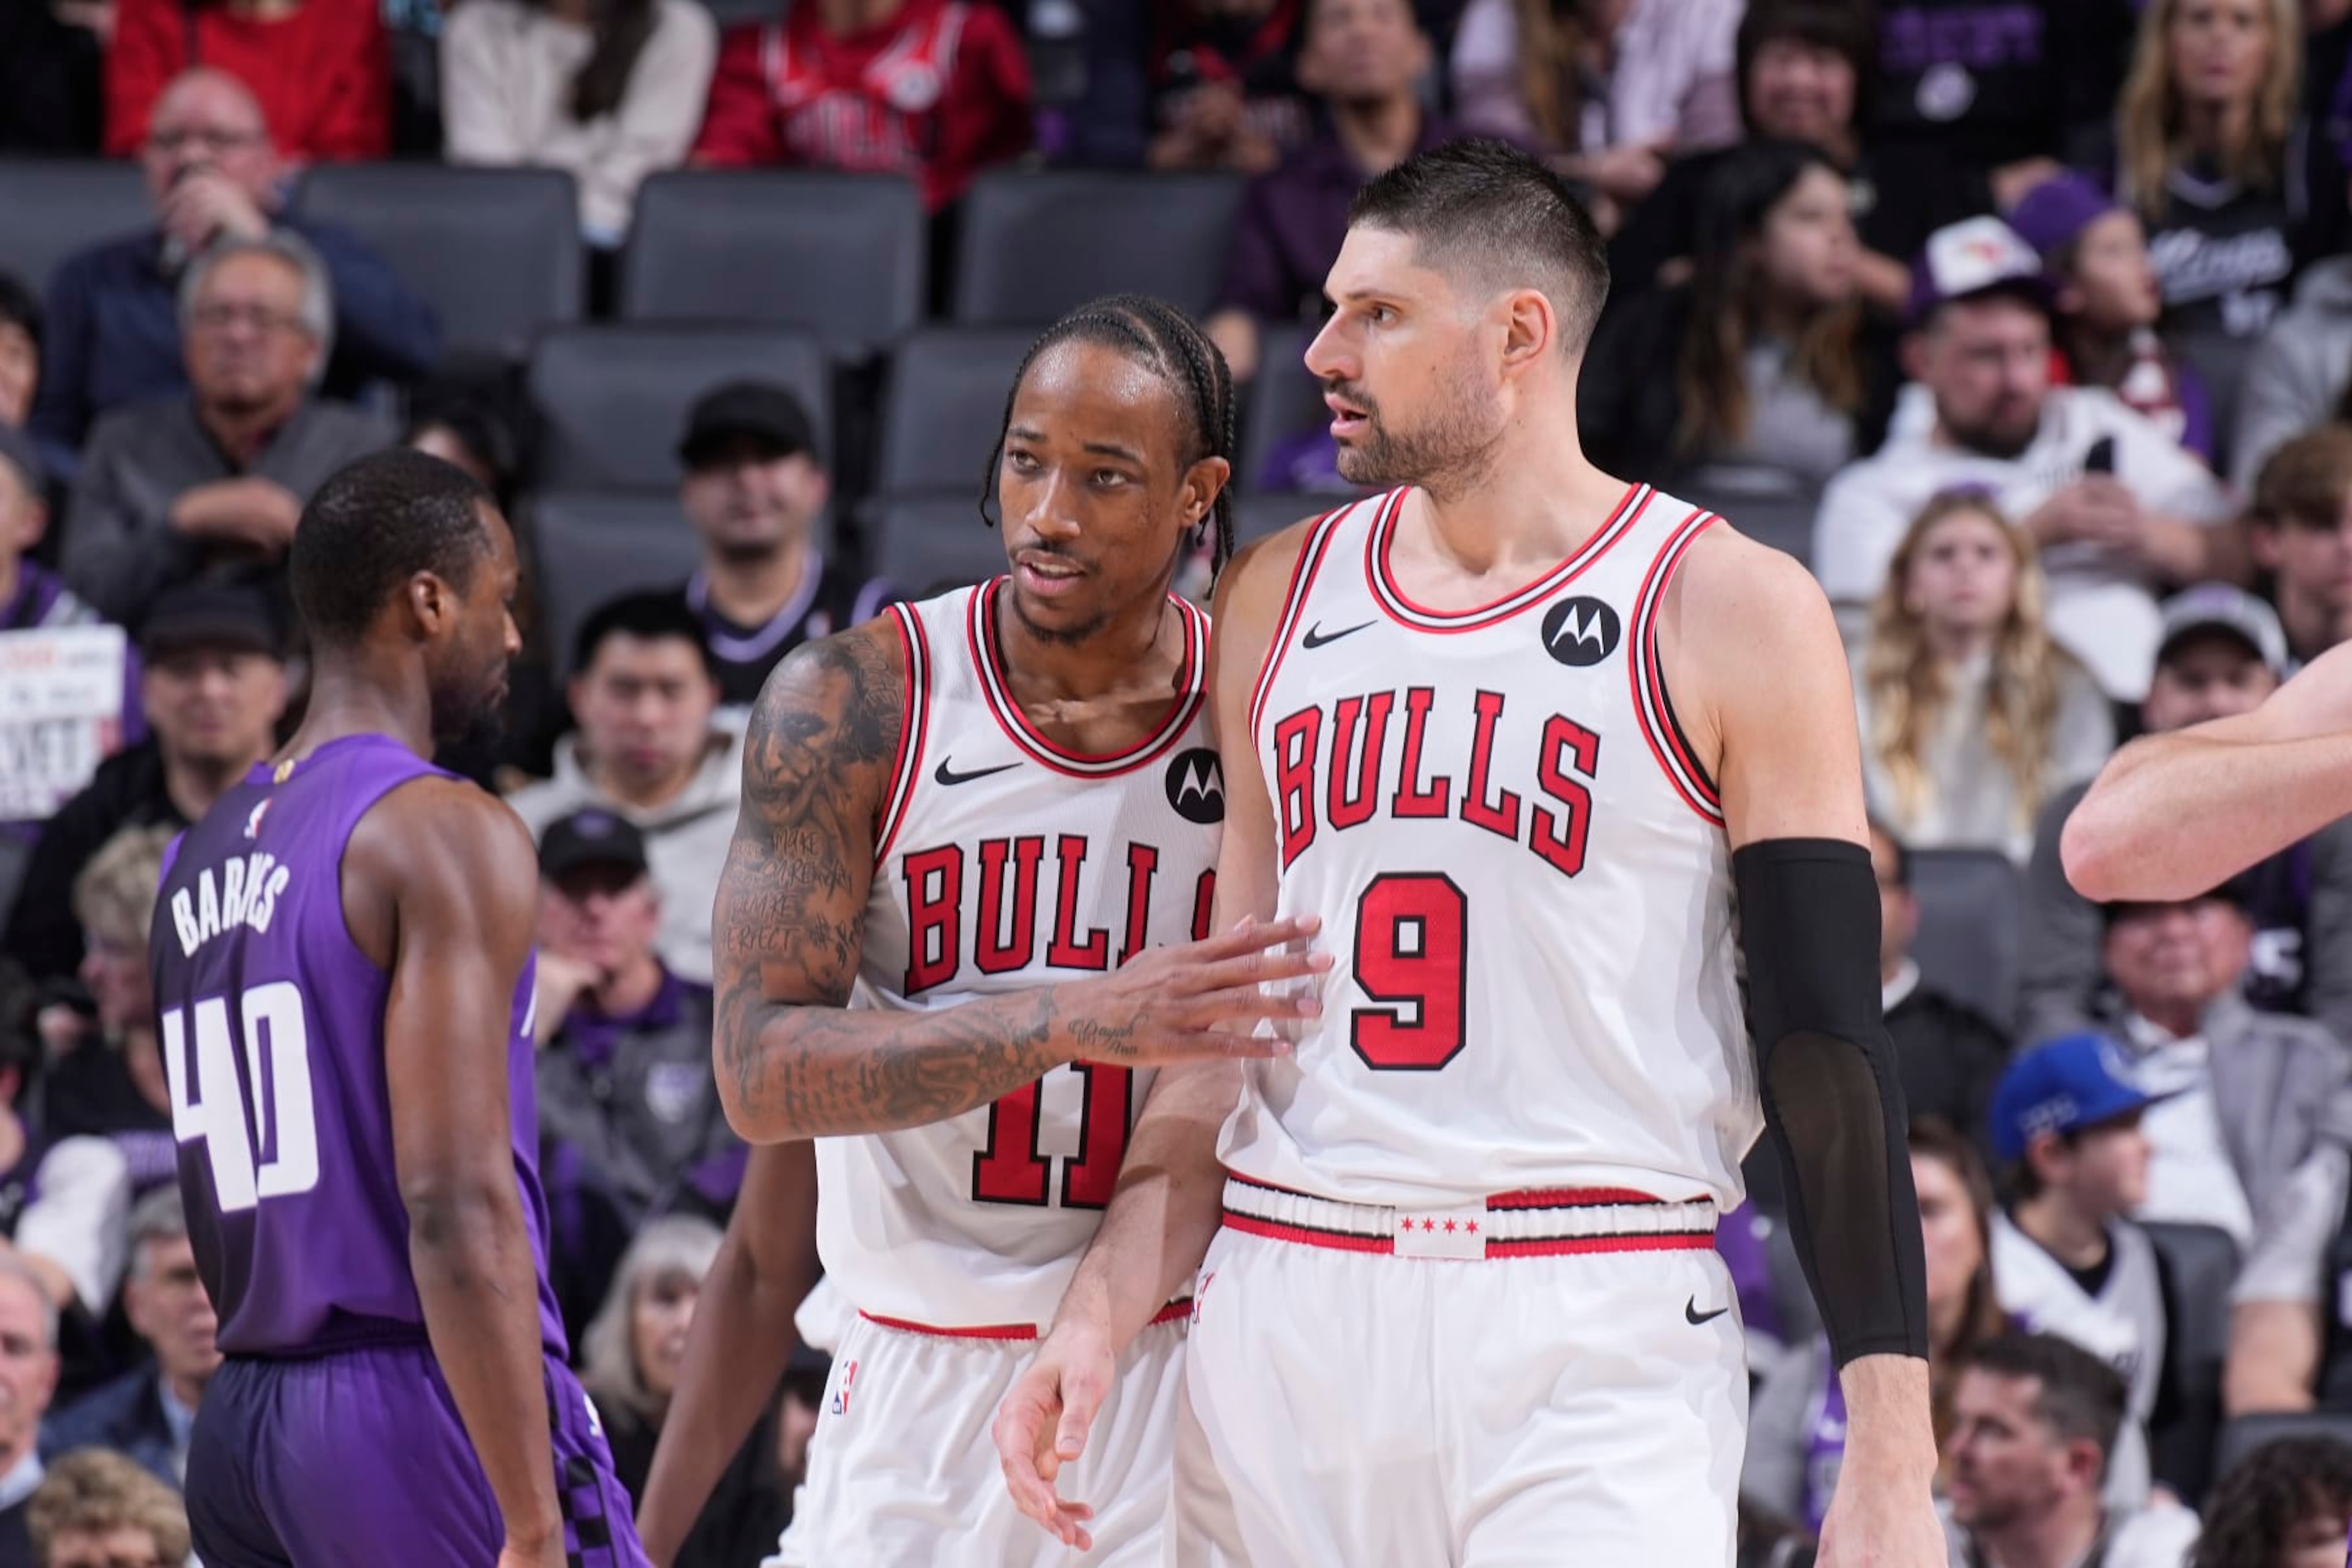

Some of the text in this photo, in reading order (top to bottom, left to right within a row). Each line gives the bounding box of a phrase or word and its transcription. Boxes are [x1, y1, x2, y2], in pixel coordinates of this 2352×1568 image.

[1273, 686, 1600, 878] BULLS
[903, 834, 1216, 998] BULL
[1350, 872, 1468, 1071] 9
[162, 980, 319, 1212] 40
[972, 1059, 1133, 1208] 11
